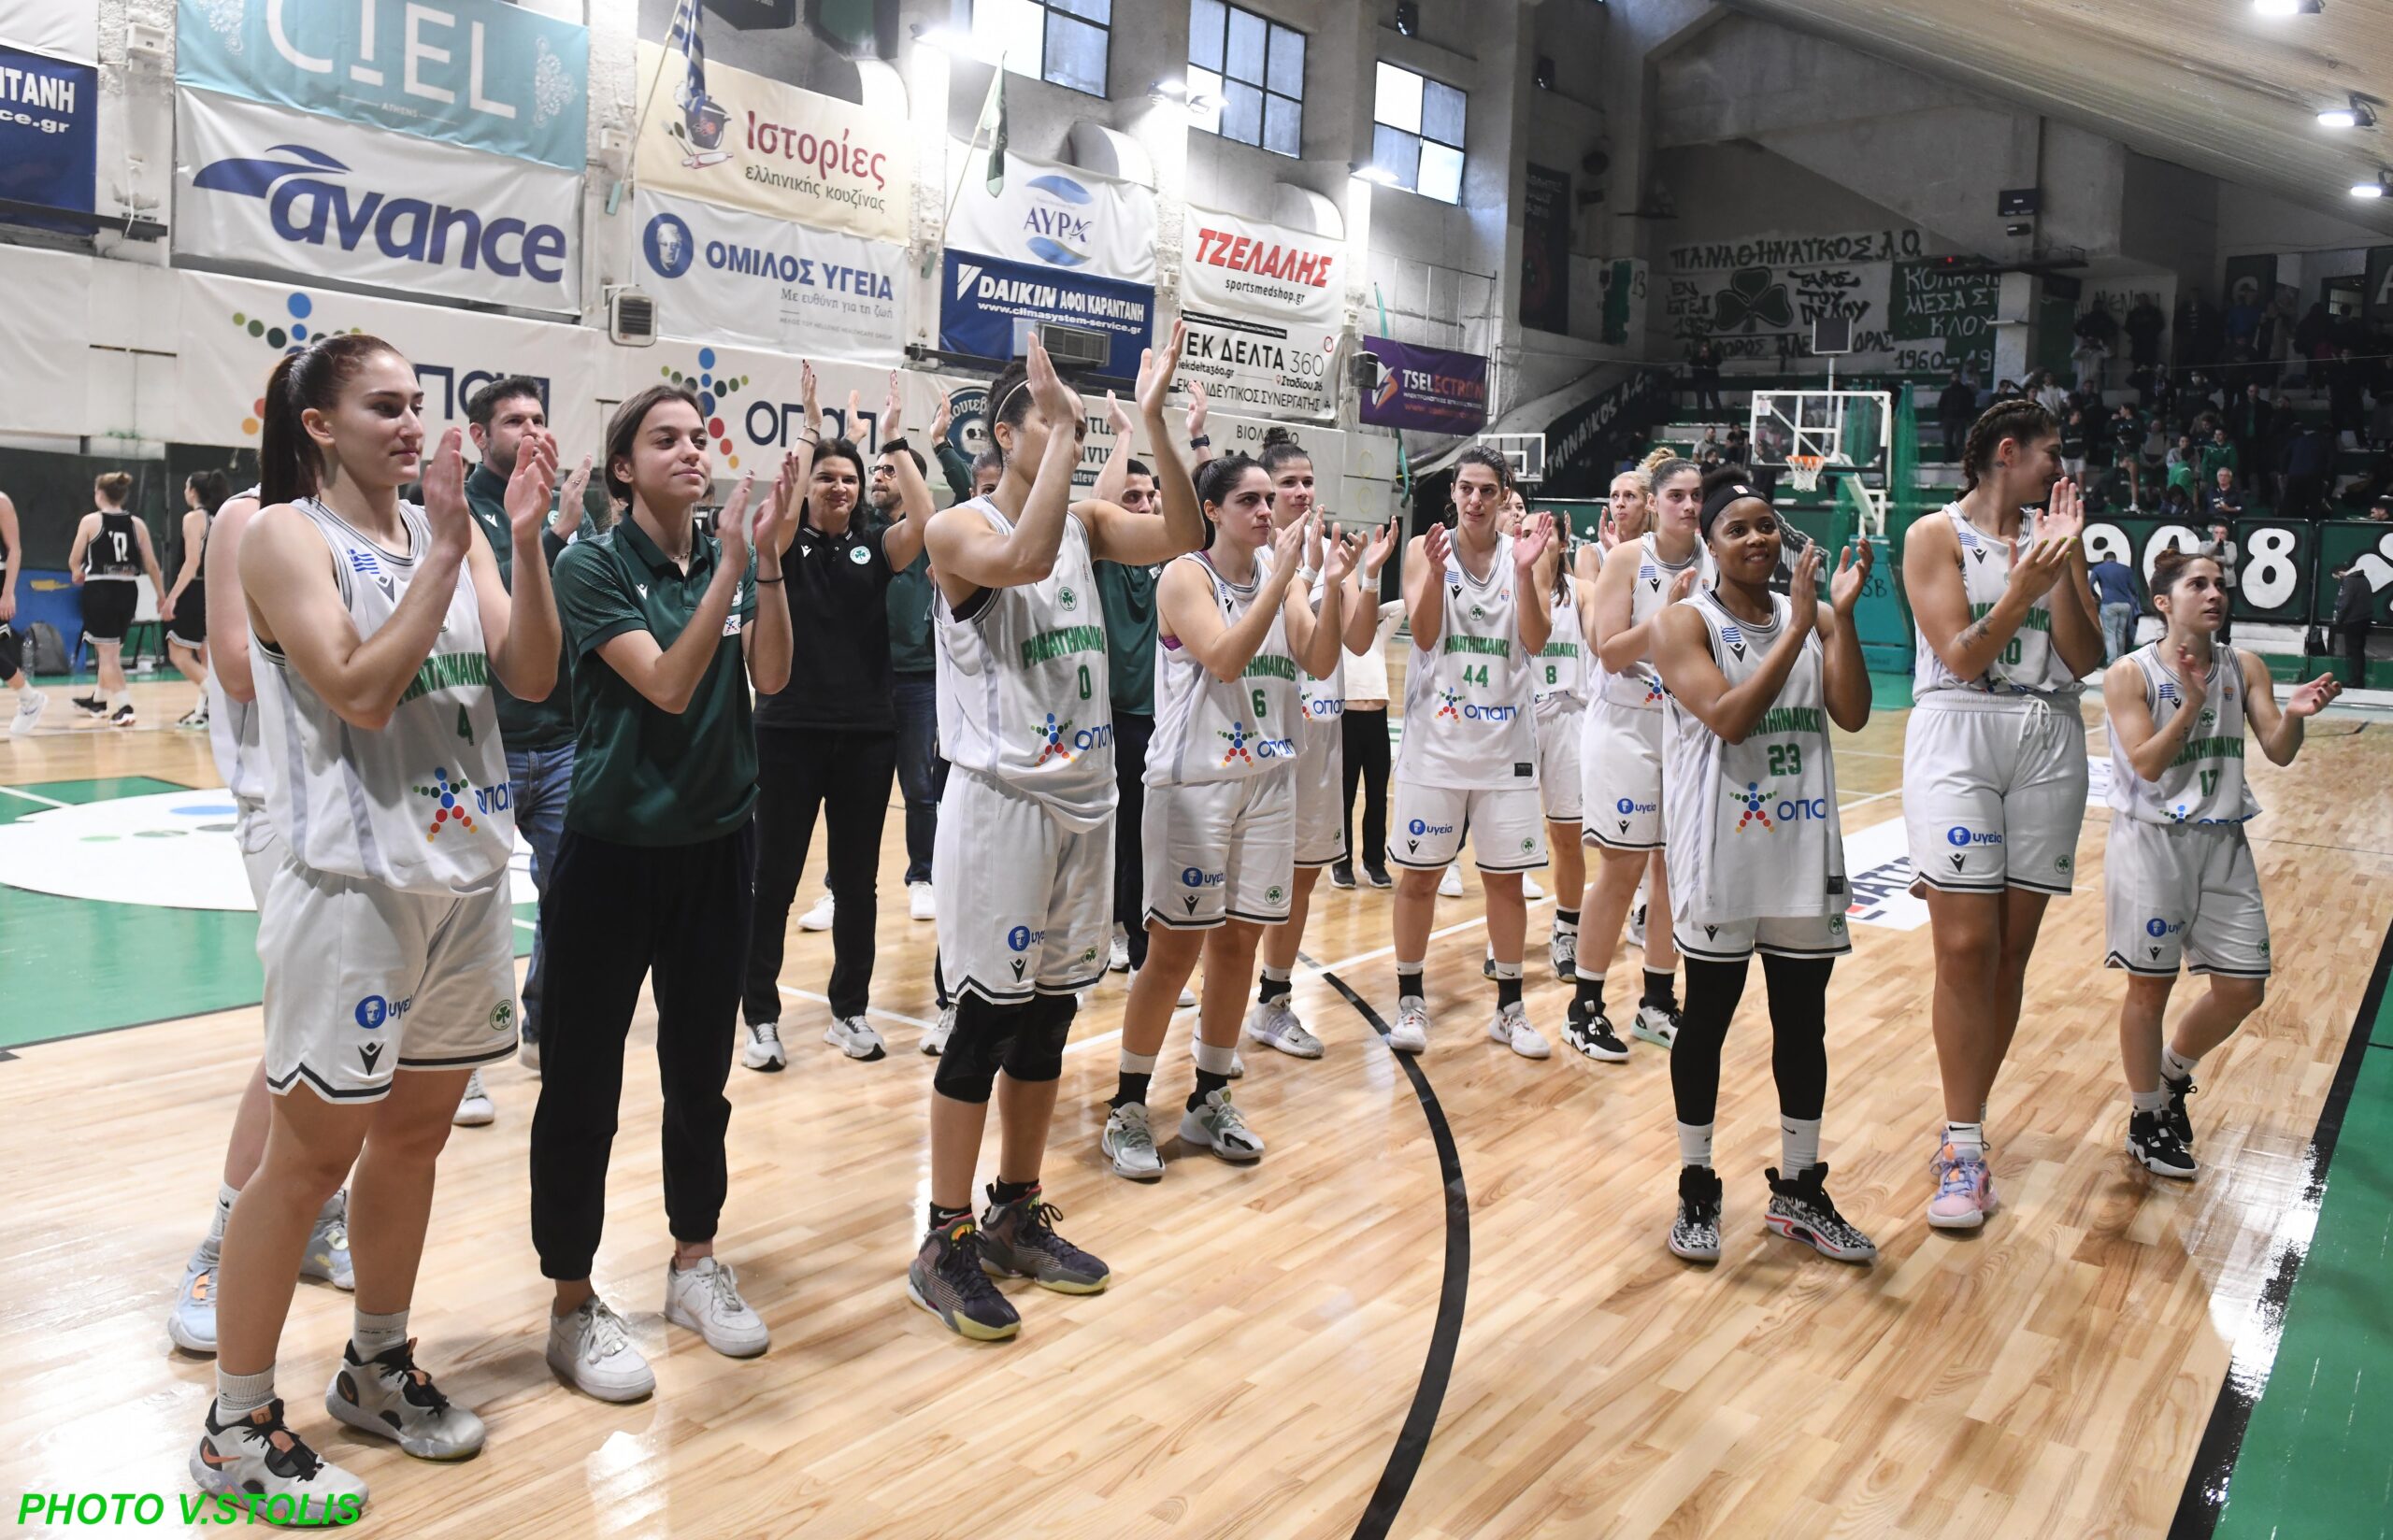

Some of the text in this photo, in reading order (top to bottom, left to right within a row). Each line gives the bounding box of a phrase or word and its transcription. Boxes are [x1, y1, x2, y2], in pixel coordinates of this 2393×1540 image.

[0, 65, 75, 114] ΤΑΝΗ
[381, 102, 419, 119] ATHENS
[748, 109, 886, 192] Ιστορίες
[745, 165, 886, 214] ελληνικής κουζίνας
[269, 178, 566, 283] avance
[706, 240, 894, 301] ΟΜΙΛΟΣ ΥΓΕΙΑ
[1196, 228, 1332, 288] ΤΖΕΛΑΛΗΣ
[781, 288, 798, 302] Με
[978, 275, 1057, 308] DAIKIN
[1225, 278, 1306, 306] sportsmedshop.gr
[977, 302, 1143, 335] www.climasystem-service.gr
[1220, 337, 1284, 371] ΔΕΛΤΑ
[1289, 349, 1325, 378] 360
[1177, 378, 1321, 412] ΕΚΙΔΕΥΤΙΚΟΣ ΣΥΝΕΡΓΑΤΗΣ
[1077, 663, 1092, 700] 0
[1463, 664, 1489, 688] 44
[1545, 664, 1556, 685] 8
[1253, 689, 1267, 719] 6
[1768, 743, 1802, 777] 23
[2200, 769, 2219, 798] 17
